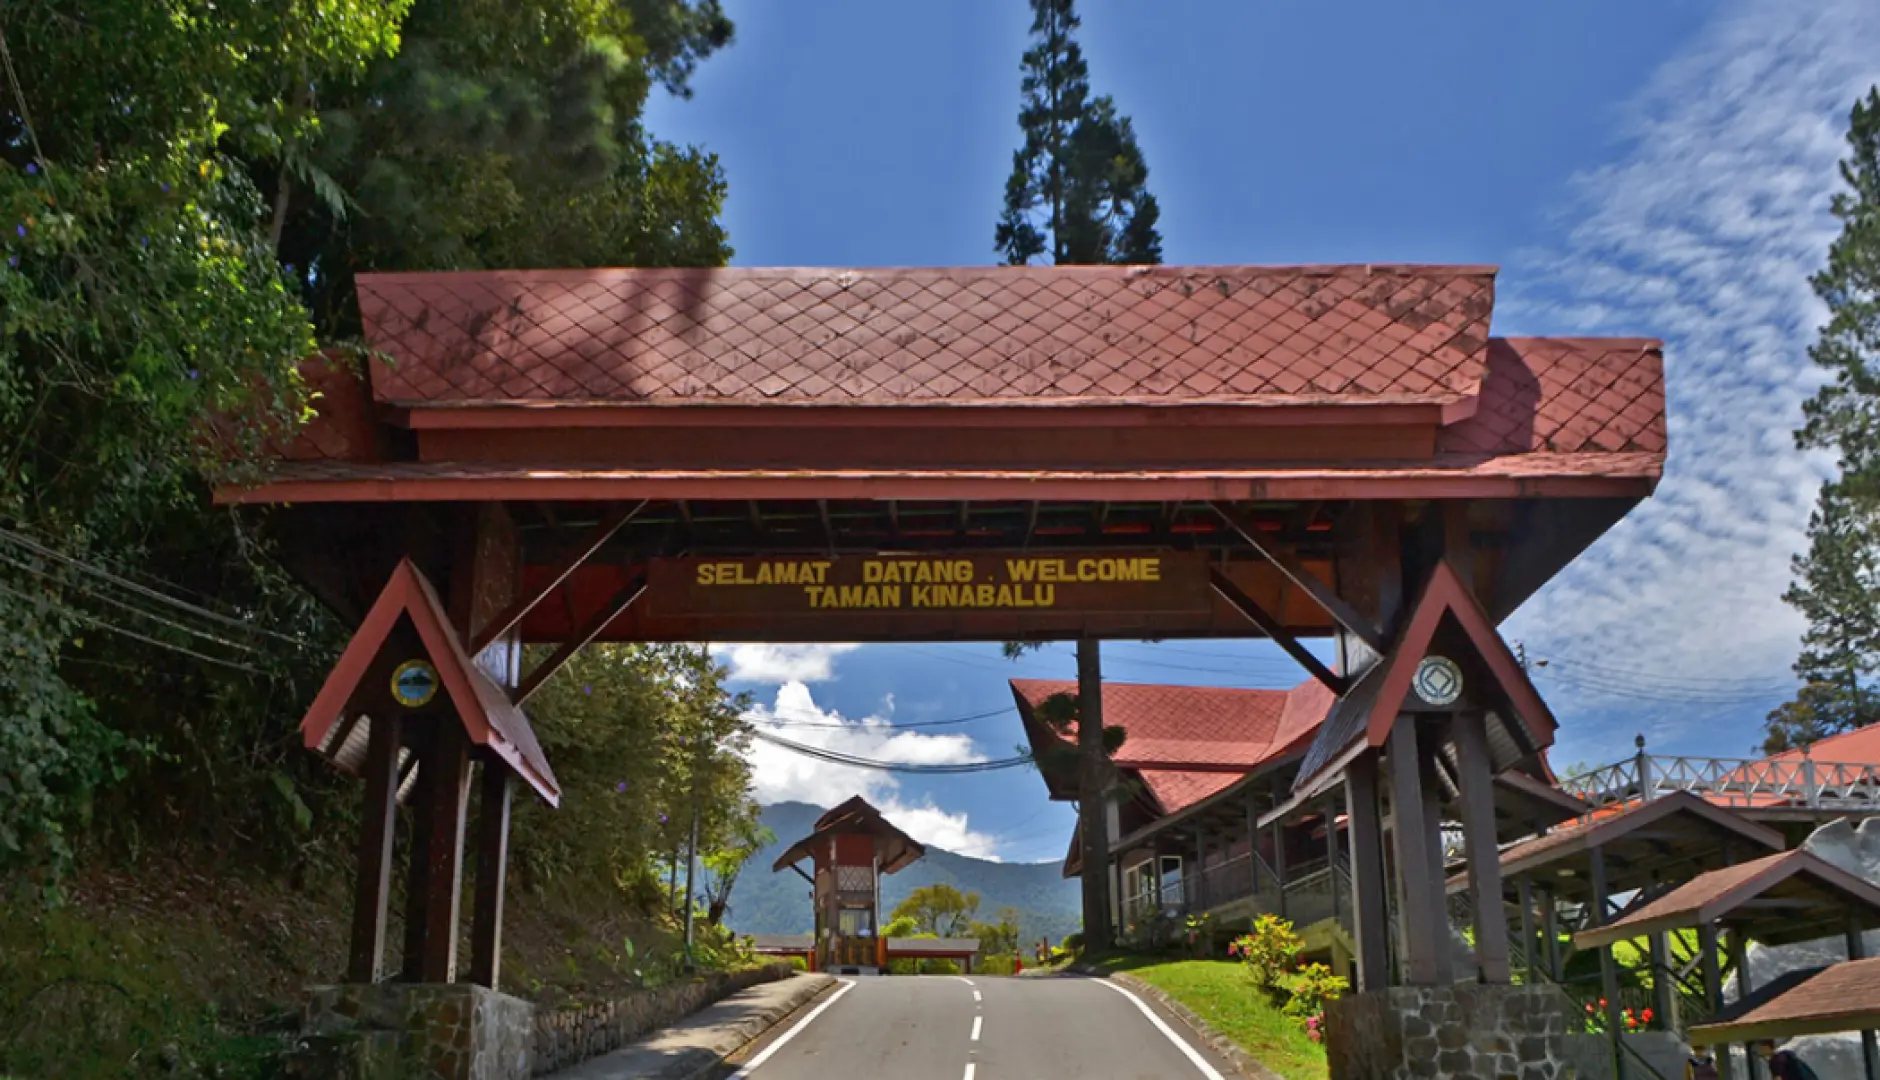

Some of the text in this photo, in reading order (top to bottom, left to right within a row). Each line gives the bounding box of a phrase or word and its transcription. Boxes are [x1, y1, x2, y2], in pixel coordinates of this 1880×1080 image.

[697, 562, 831, 584] SELAMAT
[864, 560, 973, 583] DATANG
[1006, 558, 1161, 582] WELCOME
[805, 583, 1055, 607] TAMAN KINABALU
